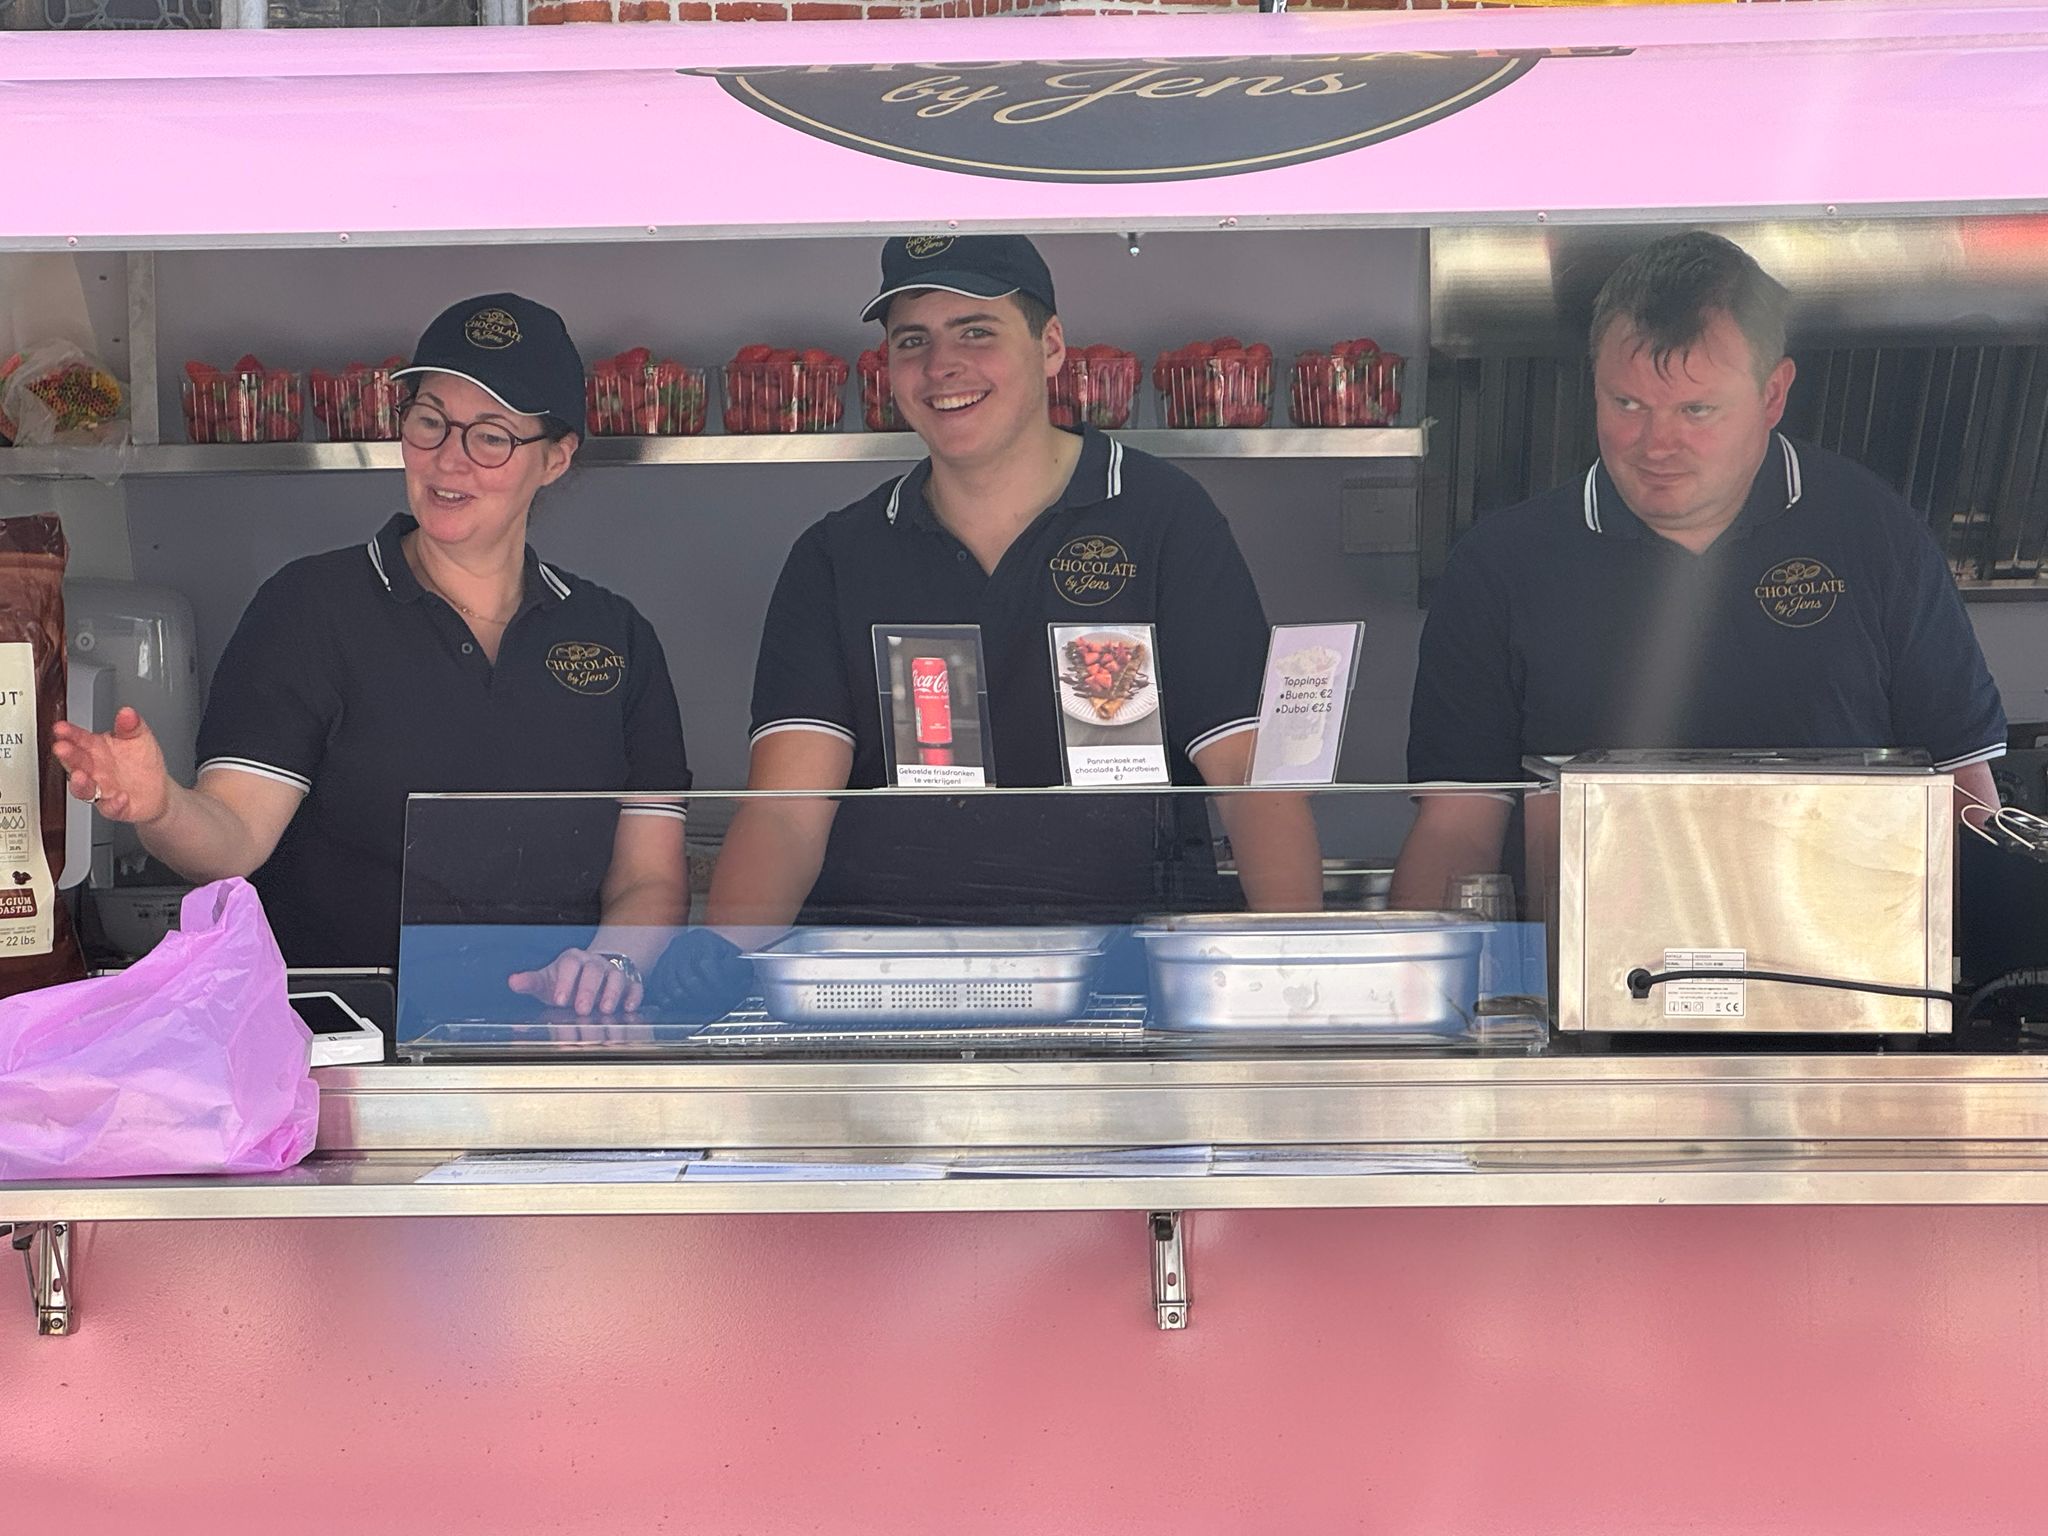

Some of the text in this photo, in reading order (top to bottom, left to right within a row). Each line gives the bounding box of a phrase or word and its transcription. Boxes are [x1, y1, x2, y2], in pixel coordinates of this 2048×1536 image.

[881, 67, 1367, 124] by Jens
[465, 320, 523, 343] CHOCOLATE
[1049, 557, 1137, 578] CHOCOLATE
[1065, 574, 1110, 595] by Jens
[1754, 579, 1846, 599] CHOCOLATE
[1774, 595, 1822, 618] by Jens
[545, 655, 625, 671] CHOCOLATE
[567, 671, 609, 687] by Jens
[1284, 676, 1328, 687] Toppings:
[1320, 688, 1333, 699] €2
[1281, 704, 1310, 714] Dubai
[1087, 757, 1131, 765] Pannenkoek
[898, 767, 975, 777] Gekoelde frisdranken
[1075, 766, 1114, 774] chocolade
[6, 935, 19, 947] 22
[21, 935, 36, 946] lbs
